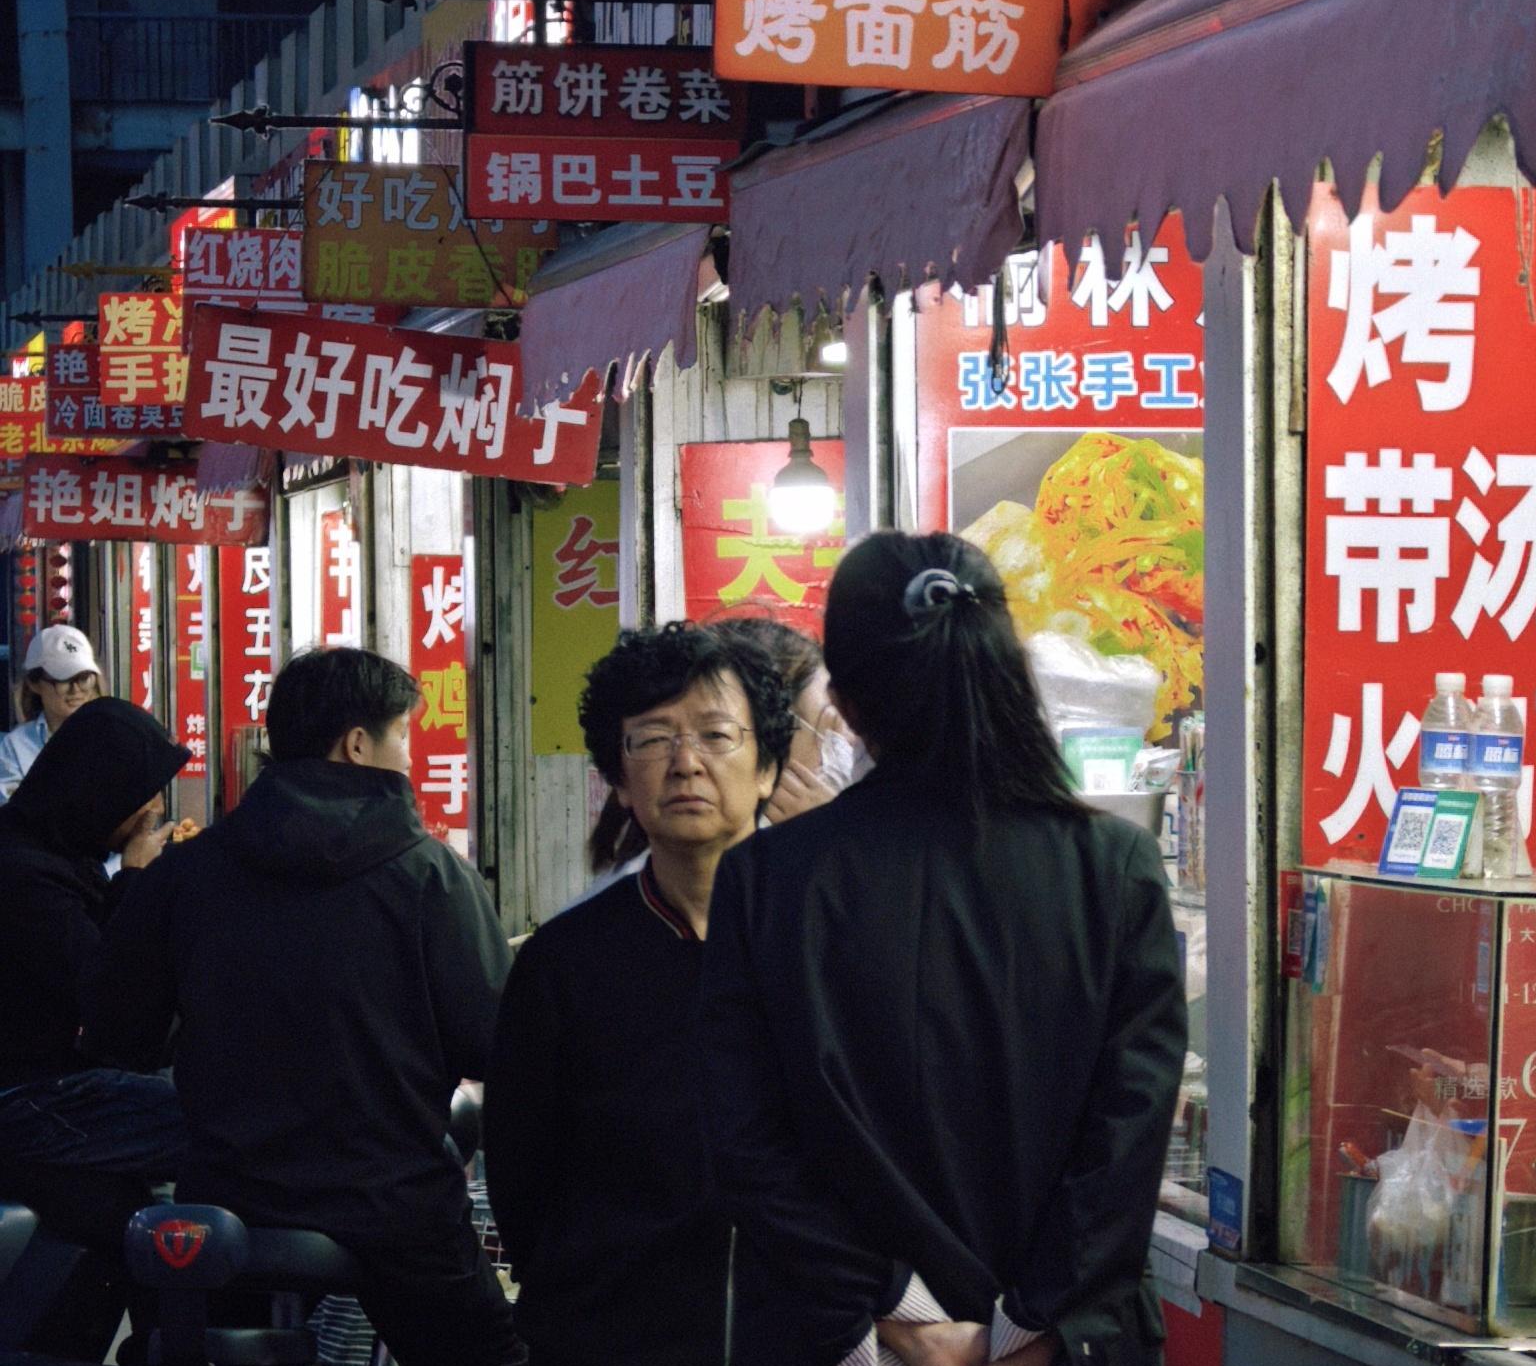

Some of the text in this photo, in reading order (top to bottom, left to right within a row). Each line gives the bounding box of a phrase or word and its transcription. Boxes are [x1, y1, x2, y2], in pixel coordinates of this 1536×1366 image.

[491, 60, 732, 126] 筋饼卷菜
[486, 153, 725, 209] 锅巴土豆
[201, 323, 588, 466] 最好吃焖子
[959, 350, 1203, 410] 张张手工
